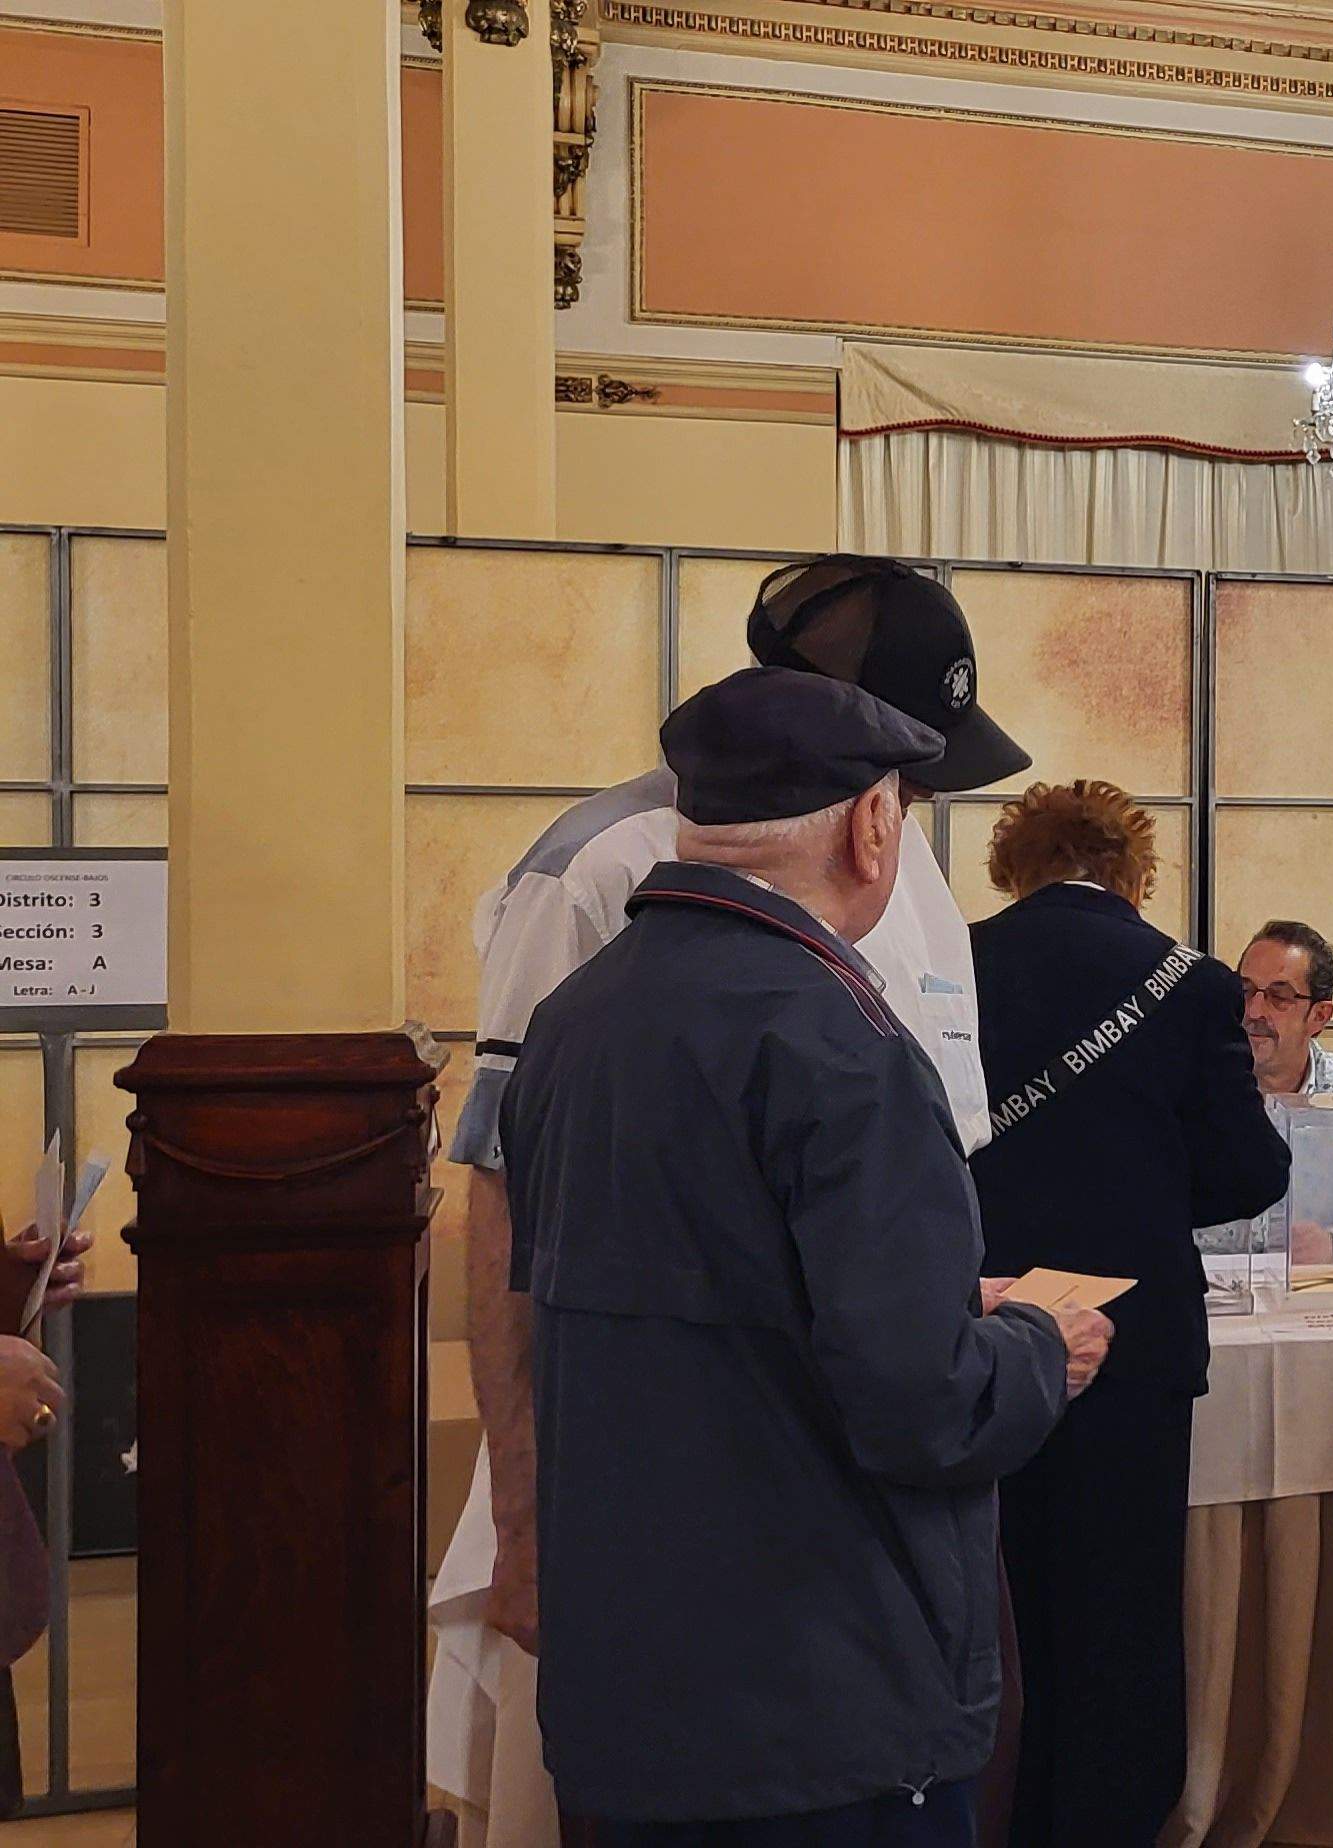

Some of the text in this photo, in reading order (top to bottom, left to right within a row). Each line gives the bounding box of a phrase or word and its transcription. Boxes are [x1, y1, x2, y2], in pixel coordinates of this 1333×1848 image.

[89, 892, 101, 907] 3
[92, 924, 103, 939] 3
[92, 955, 107, 970] A
[13, 985, 53, 996] Letra:
[1062, 995, 1145, 1075] BIMBAY
